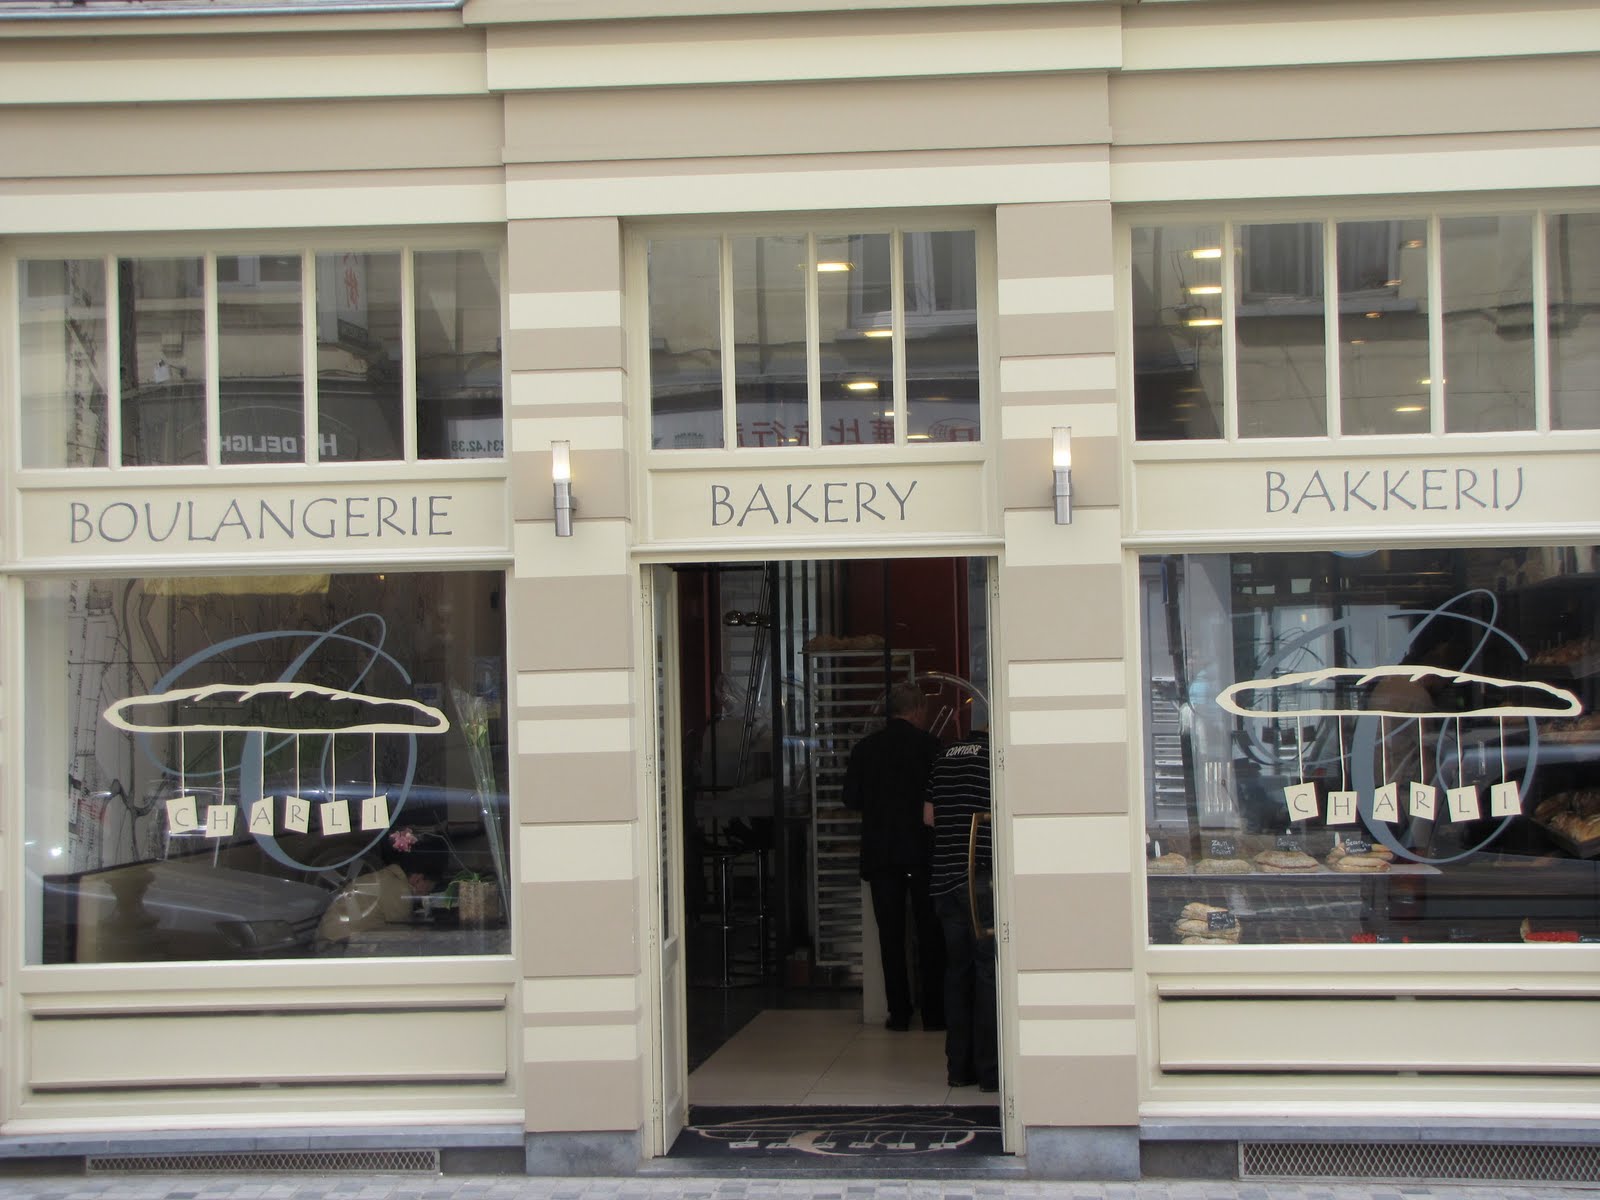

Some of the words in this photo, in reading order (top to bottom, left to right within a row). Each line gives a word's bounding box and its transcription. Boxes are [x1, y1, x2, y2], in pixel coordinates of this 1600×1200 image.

[711, 480, 918, 527] BAKERY
[1266, 467, 1524, 514] BAKKERIJ
[71, 495, 453, 544] BOULANGERIE
[175, 804, 377, 830] CHARLI
[1293, 790, 1507, 816] CHARLI
